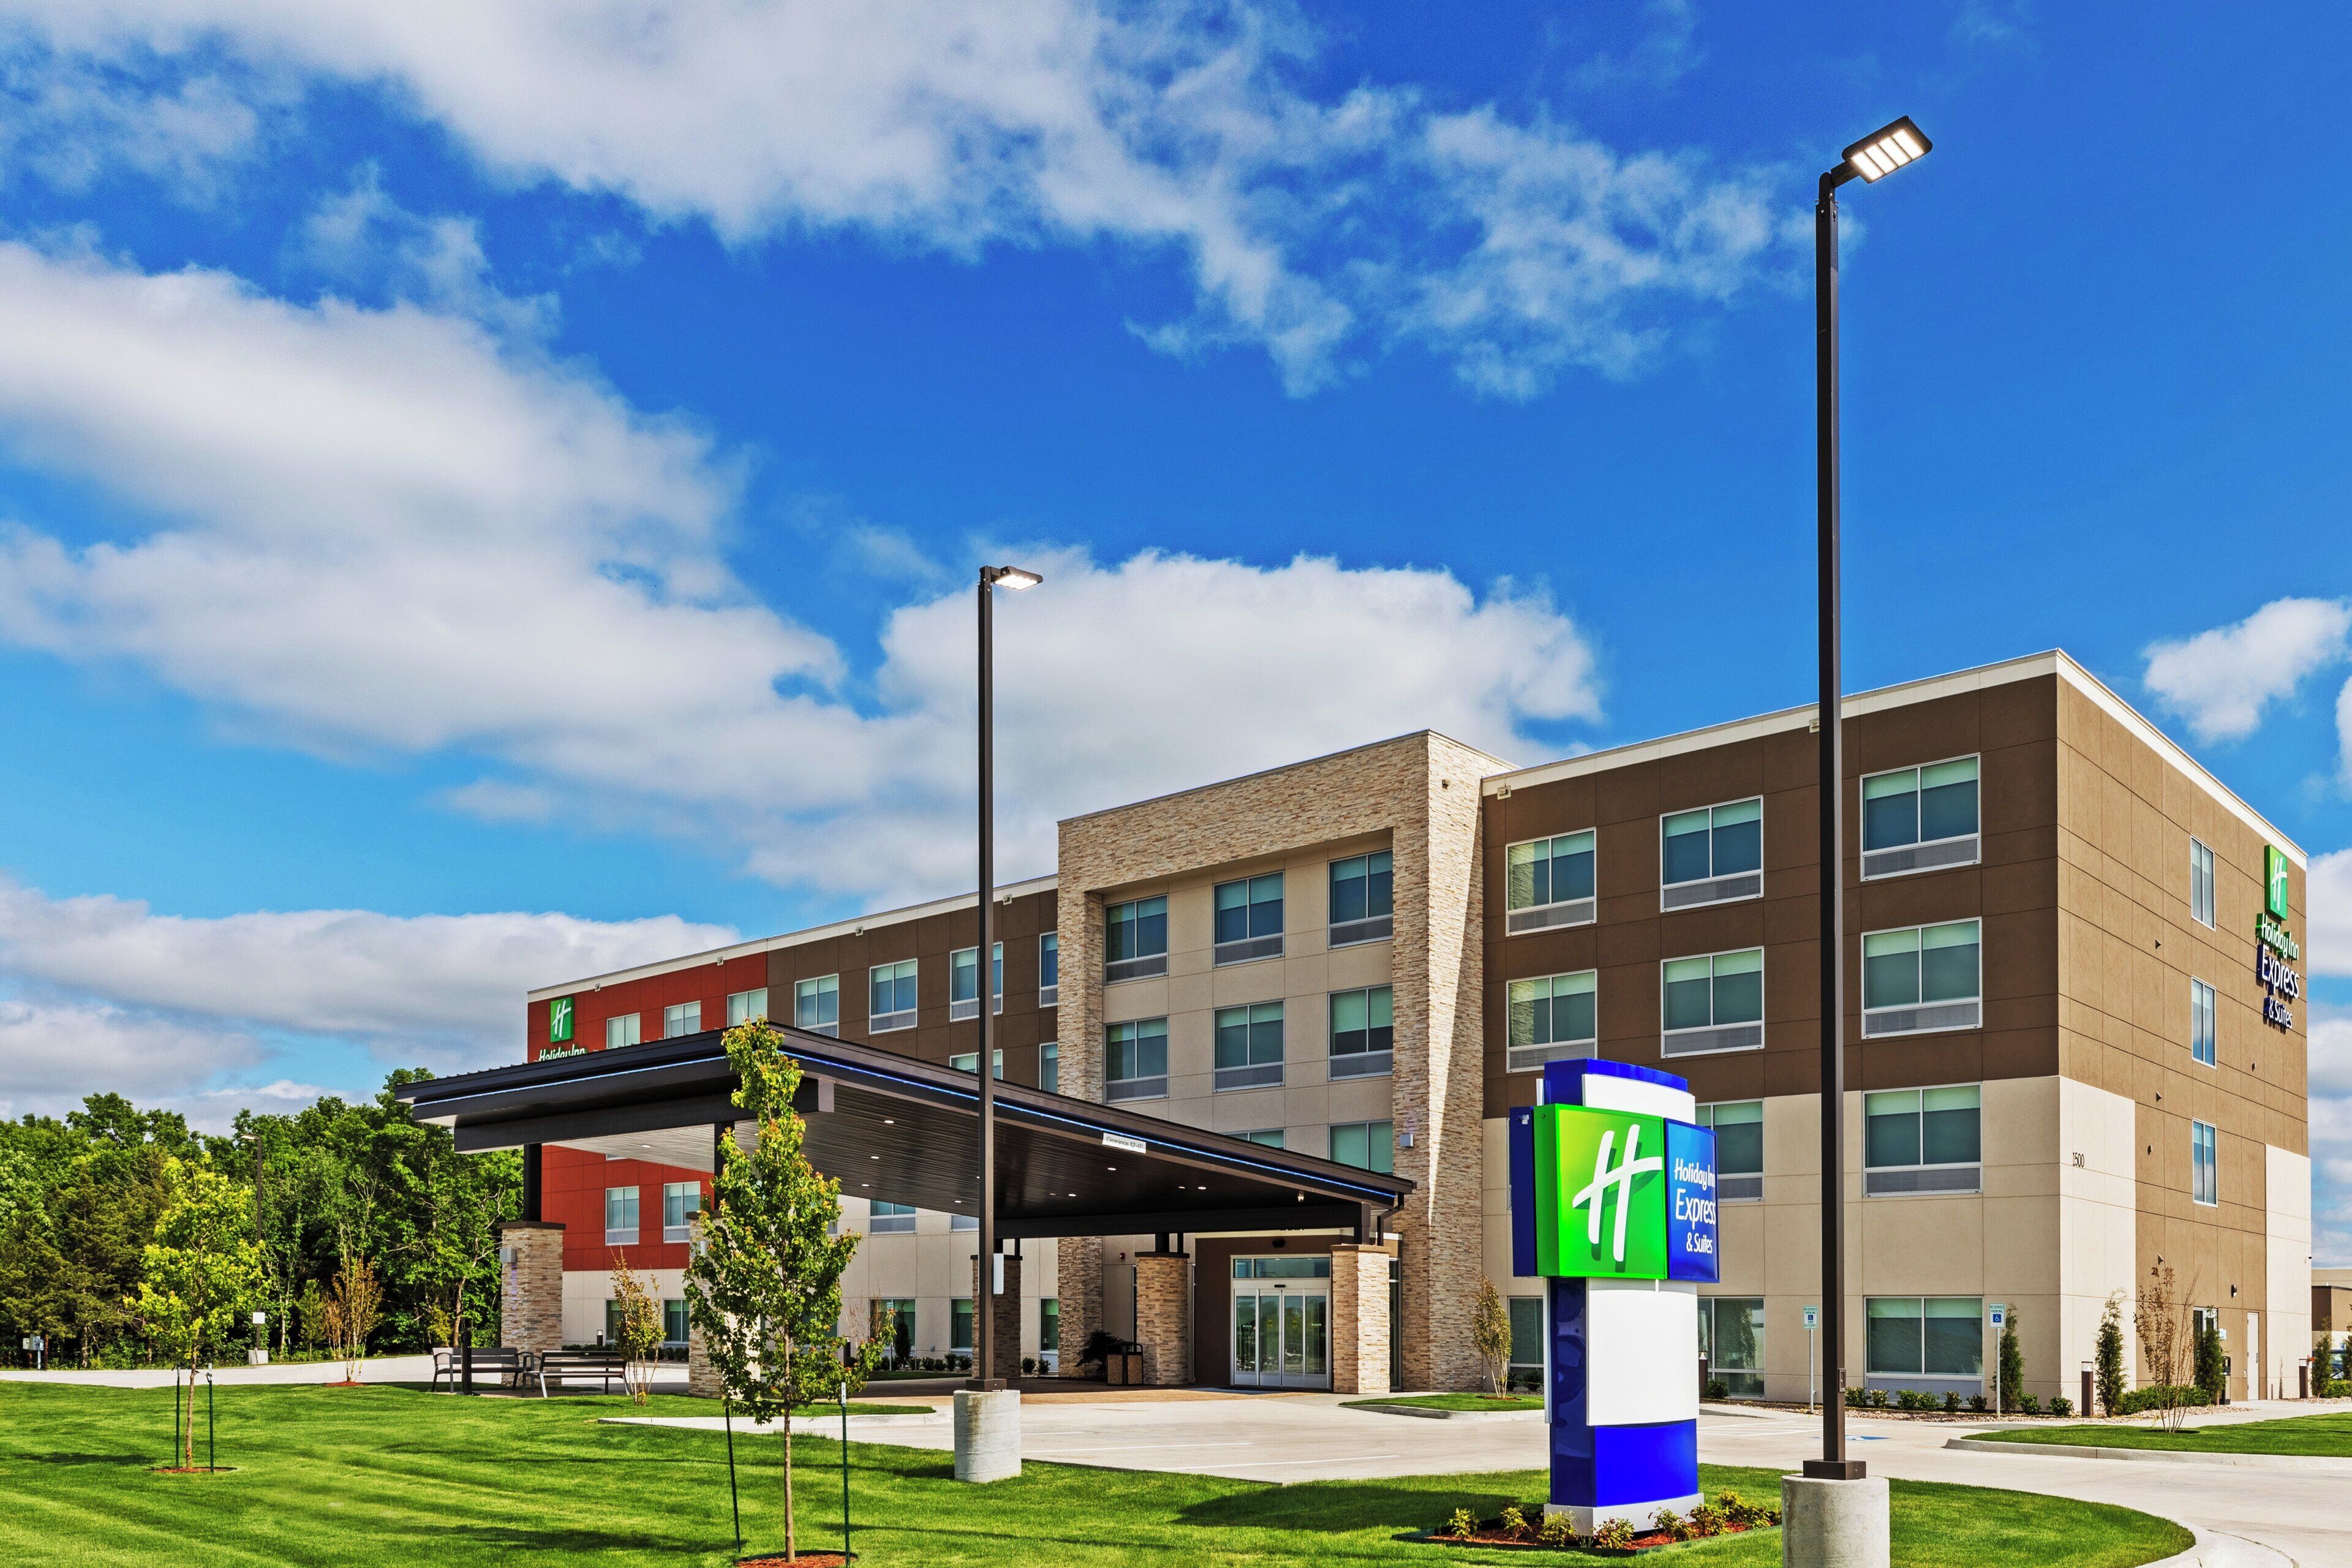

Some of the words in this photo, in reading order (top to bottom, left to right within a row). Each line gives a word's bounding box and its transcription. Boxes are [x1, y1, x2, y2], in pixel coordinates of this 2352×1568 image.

[2261, 913, 2288, 959] Holiday
[2288, 931, 2299, 960] Inn
[2261, 944, 2300, 999] Express
[2268, 997, 2275, 1019] &
[2275, 999, 2293, 1029] Suites
[571, 1044, 586, 1055] Inn
[1674, 1157, 1708, 1191] Holiday
[2073, 1152, 2085, 1167] 1500
[1675, 1188, 1716, 1231] Express
[1686, 1232, 1693, 1253] &
[1694, 1233, 1713, 1254] Suites
